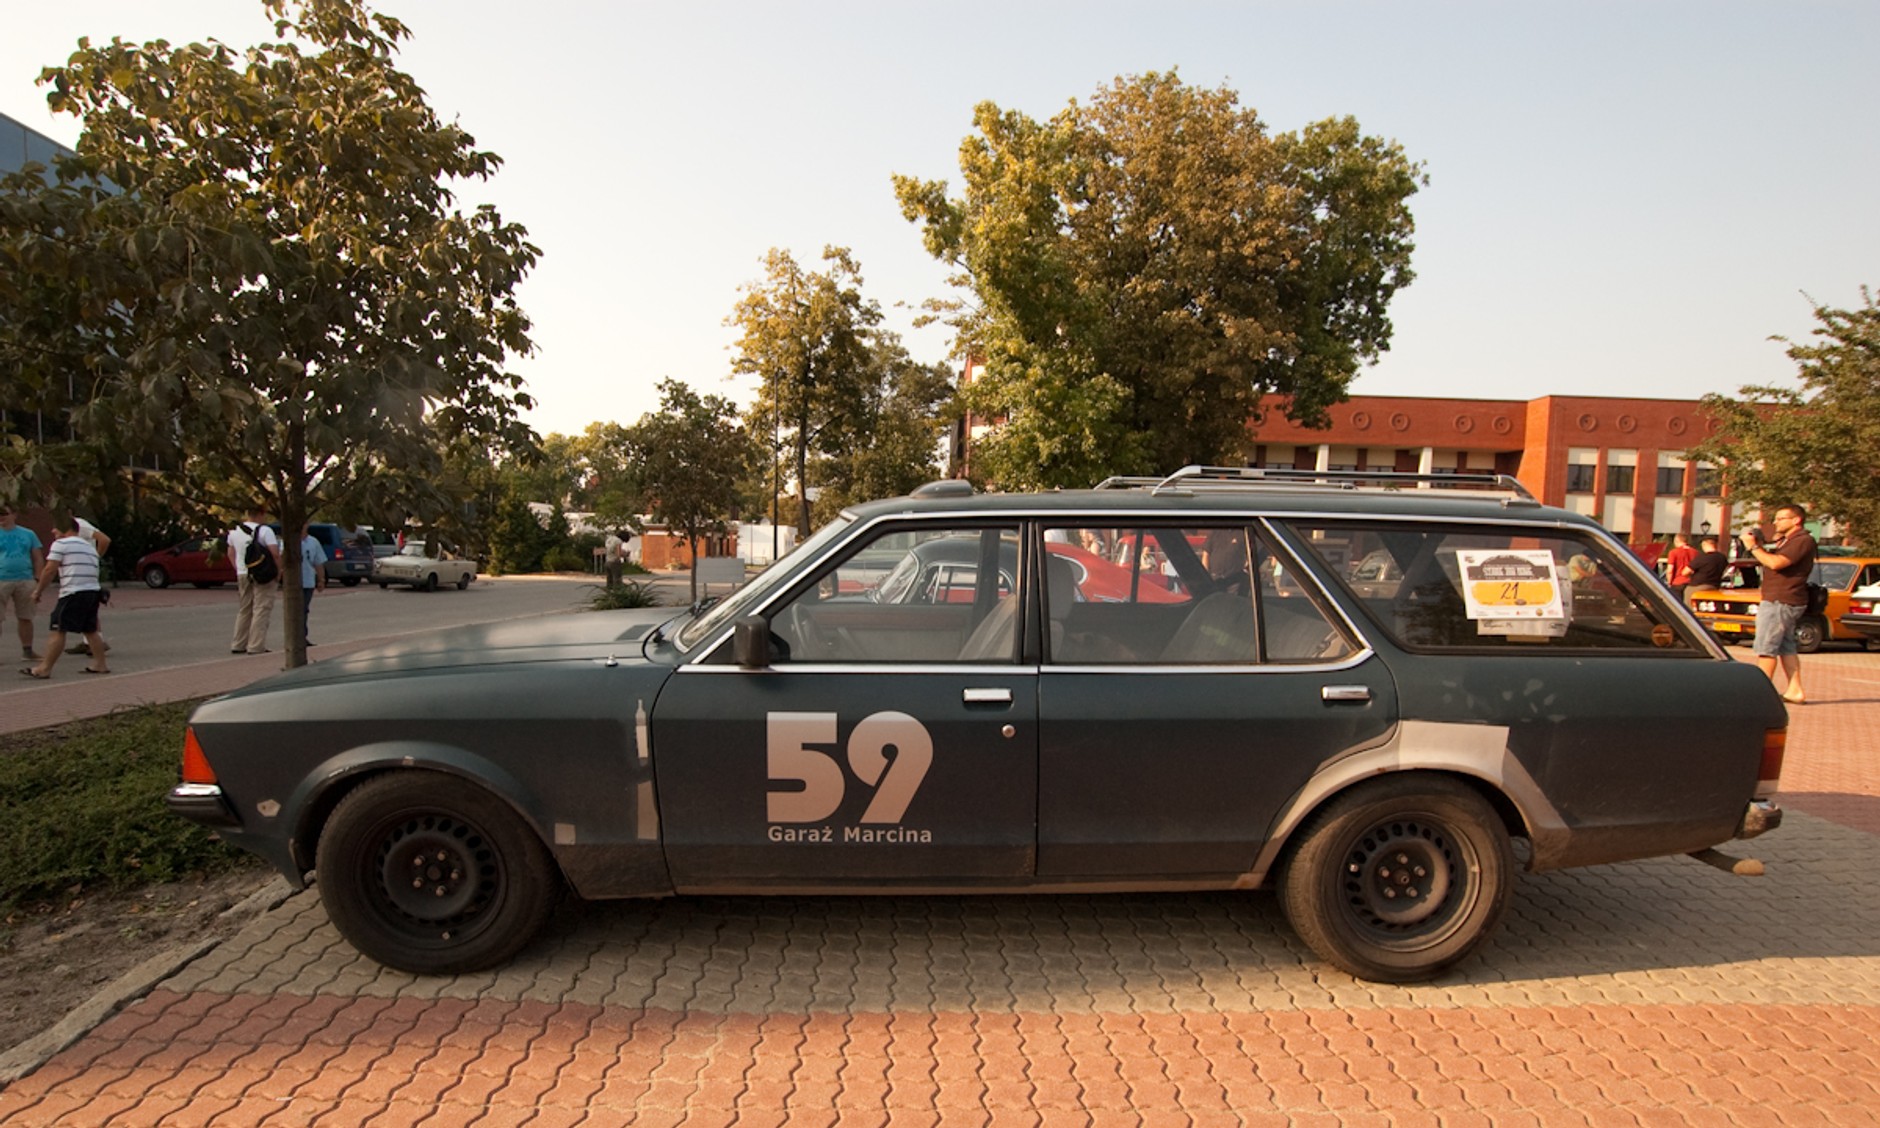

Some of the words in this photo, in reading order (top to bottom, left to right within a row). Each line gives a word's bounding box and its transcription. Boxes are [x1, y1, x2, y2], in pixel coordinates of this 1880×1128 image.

[1501, 581, 1520, 600] 21
[767, 711, 934, 823] 59
[767, 826, 833, 843] Garaż
[844, 826, 932, 843] Marcina
